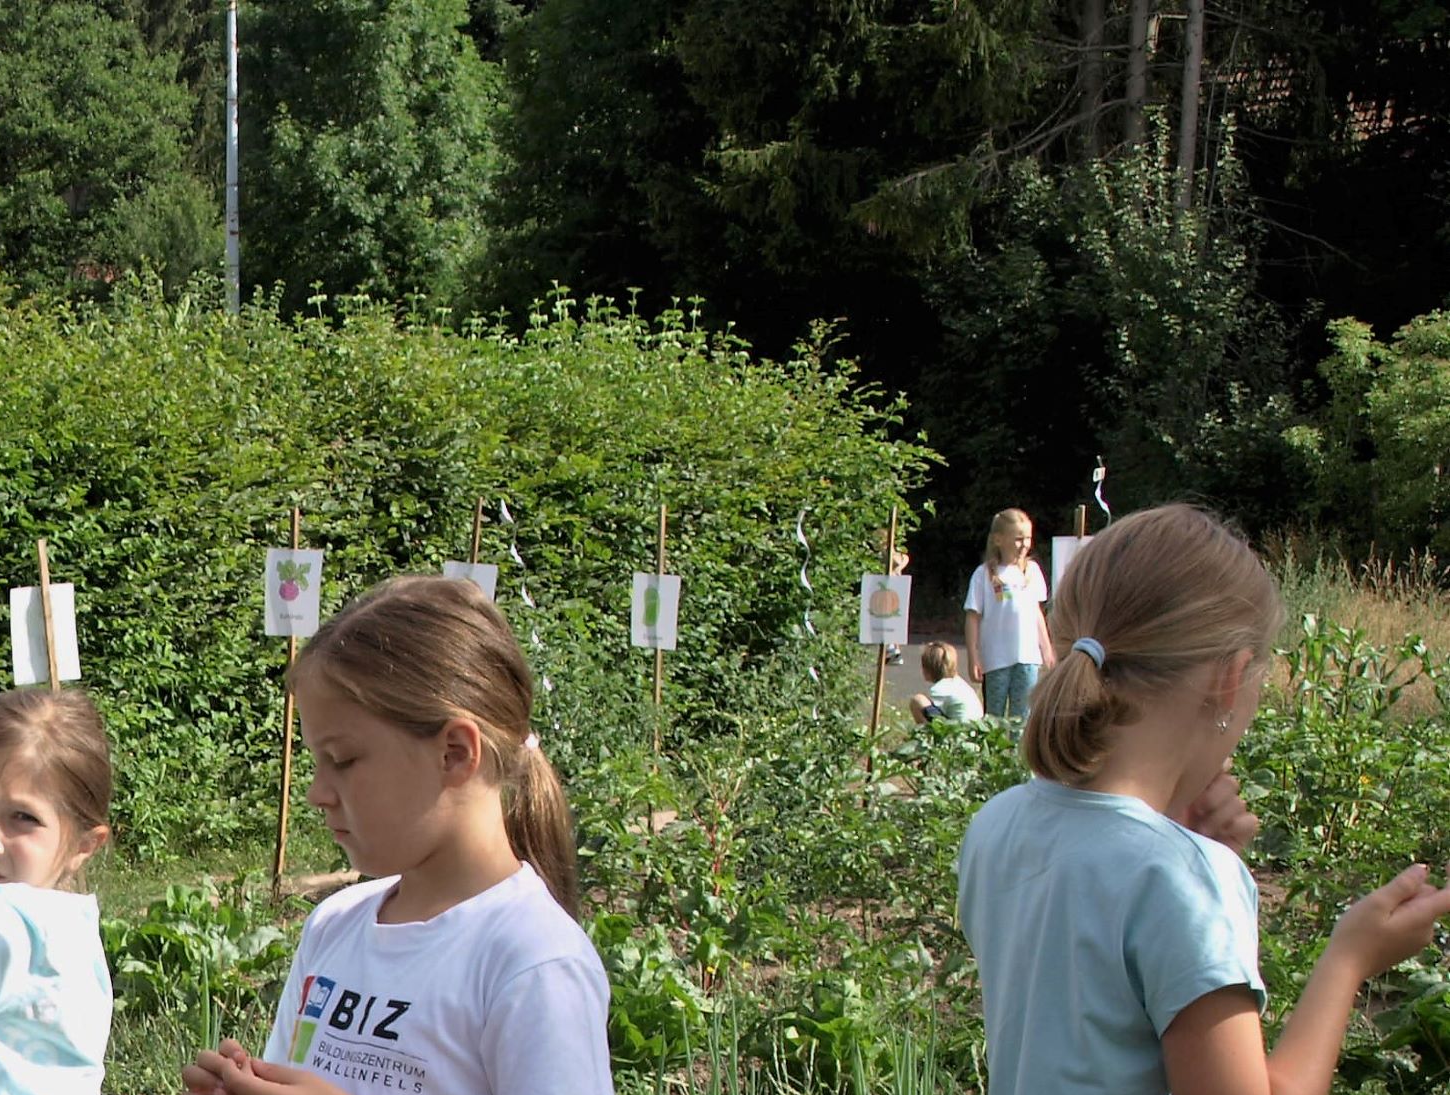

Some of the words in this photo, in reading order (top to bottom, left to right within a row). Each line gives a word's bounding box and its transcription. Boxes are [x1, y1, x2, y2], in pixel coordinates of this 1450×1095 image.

[328, 989, 412, 1041] BIZ
[312, 1055, 423, 1094] WALLENFELS
[318, 1041, 426, 1079] BILDUNGSZENTRUM
